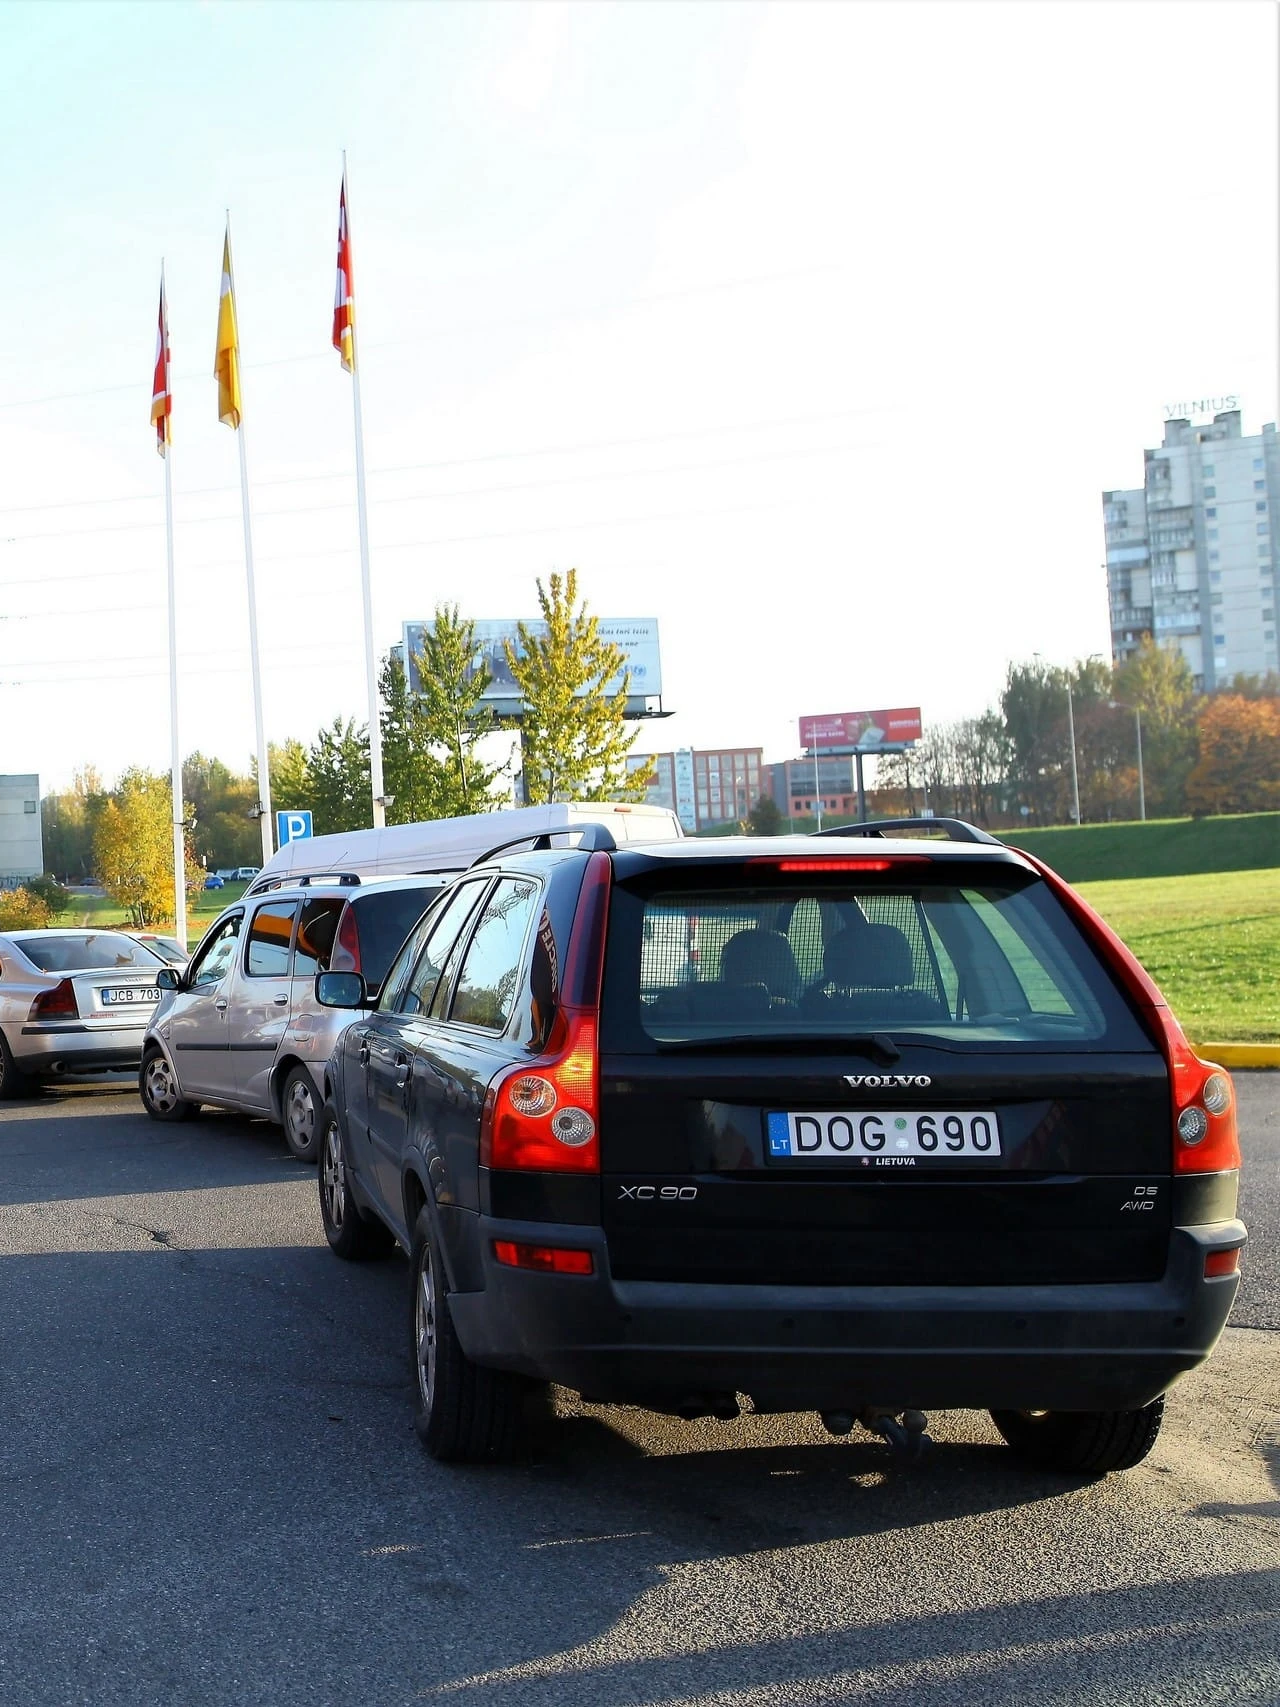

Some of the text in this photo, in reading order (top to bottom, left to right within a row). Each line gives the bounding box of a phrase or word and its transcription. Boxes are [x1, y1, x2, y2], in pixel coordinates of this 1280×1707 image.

[1164, 395, 1239, 416] VILNIUS
[287, 816, 306, 841] P
[110, 988, 160, 1001] JCB 703
[843, 1075, 932, 1088] VOLVO
[771, 1116, 992, 1152] LT DOG 690
[875, 1157, 916, 1166] LIETUVA
[1120, 1201, 1155, 1211] AWD
